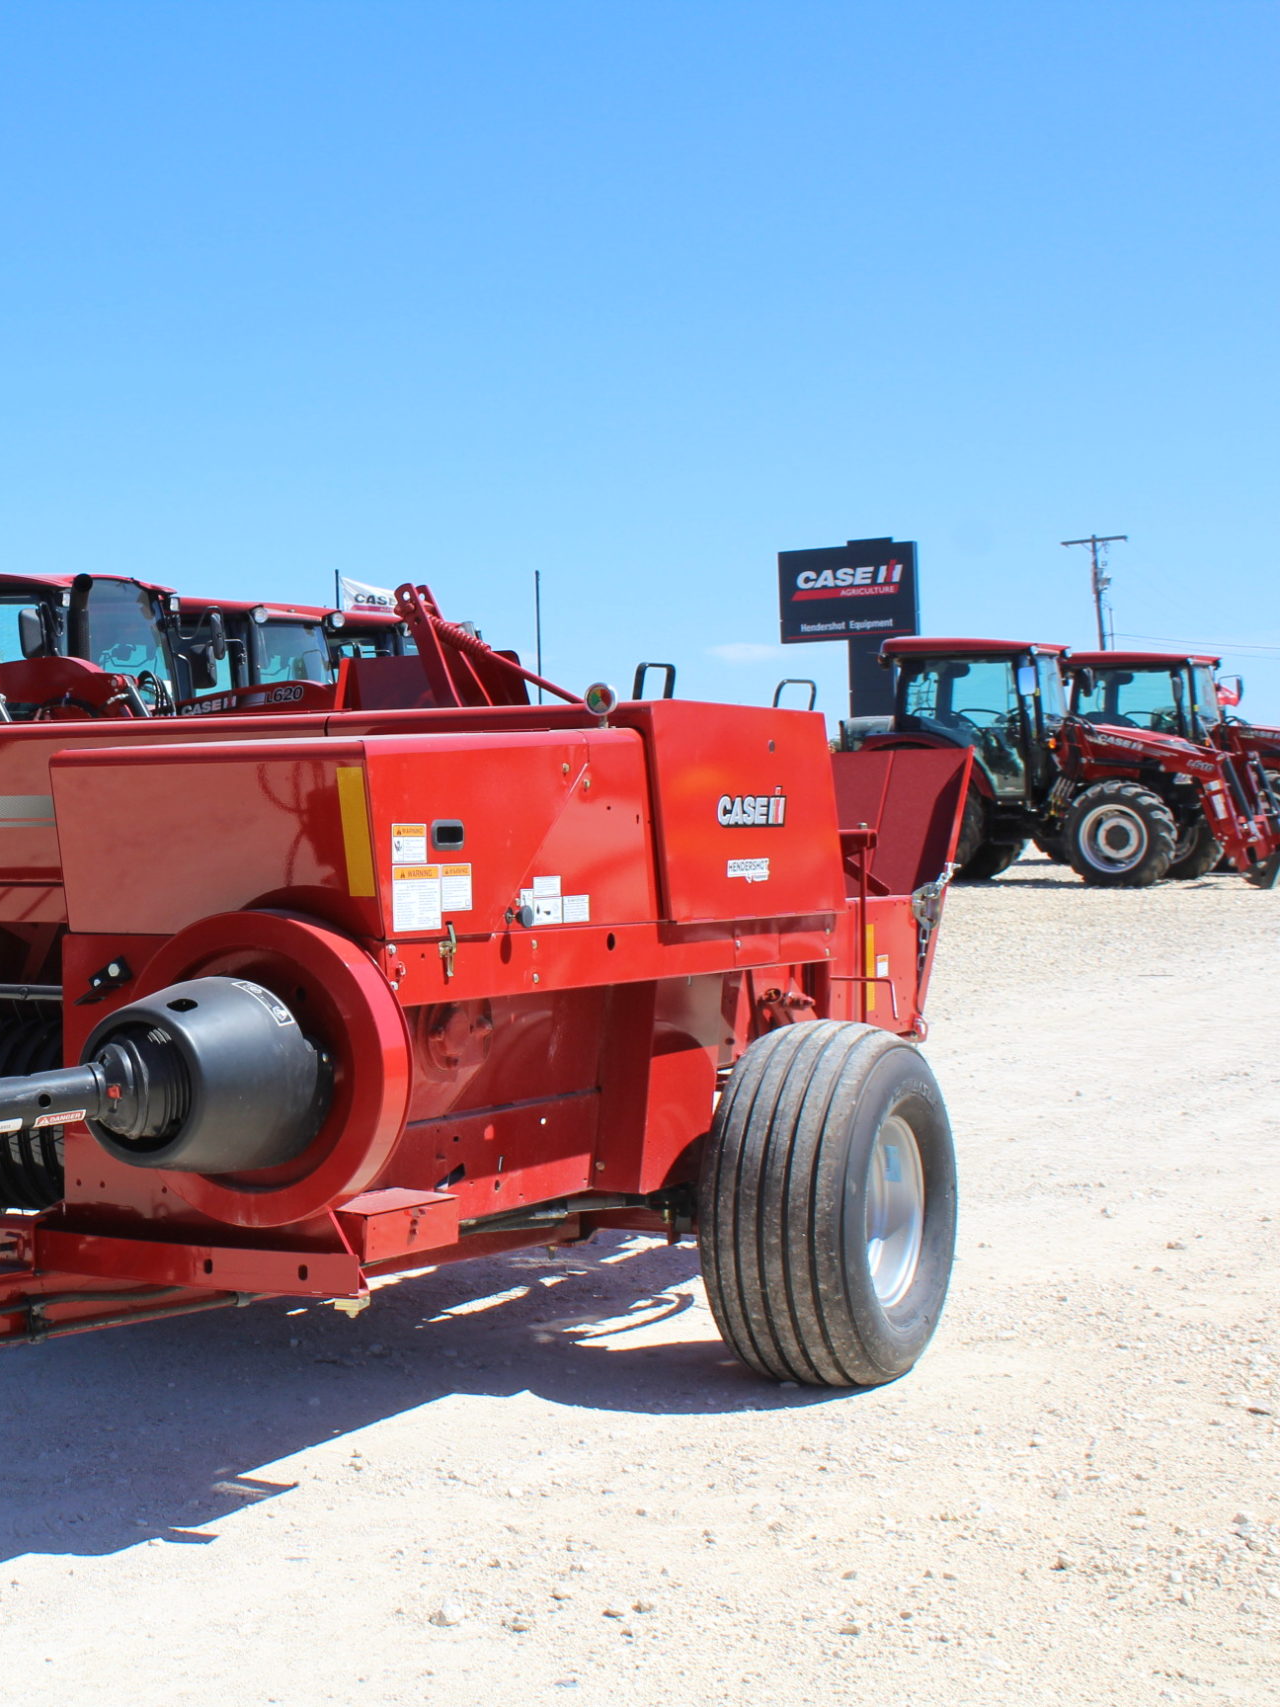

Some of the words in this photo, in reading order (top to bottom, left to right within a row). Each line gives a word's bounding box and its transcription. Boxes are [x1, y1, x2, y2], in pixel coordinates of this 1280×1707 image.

[796, 566, 875, 590] CASE
[841, 585, 895, 596] AGRICULTURE
[800, 621, 846, 632] Hendershot
[849, 618, 893, 630] Equipment
[181, 698, 222, 716] CASE
[265, 684, 304, 704] L620
[1098, 733, 1133, 749] CASE
[717, 794, 769, 827] CASE
[728, 860, 769, 872] HENDERSHOT
[407, 869, 433, 878] WARNING
[49, 1112, 81, 1123] DANGER
